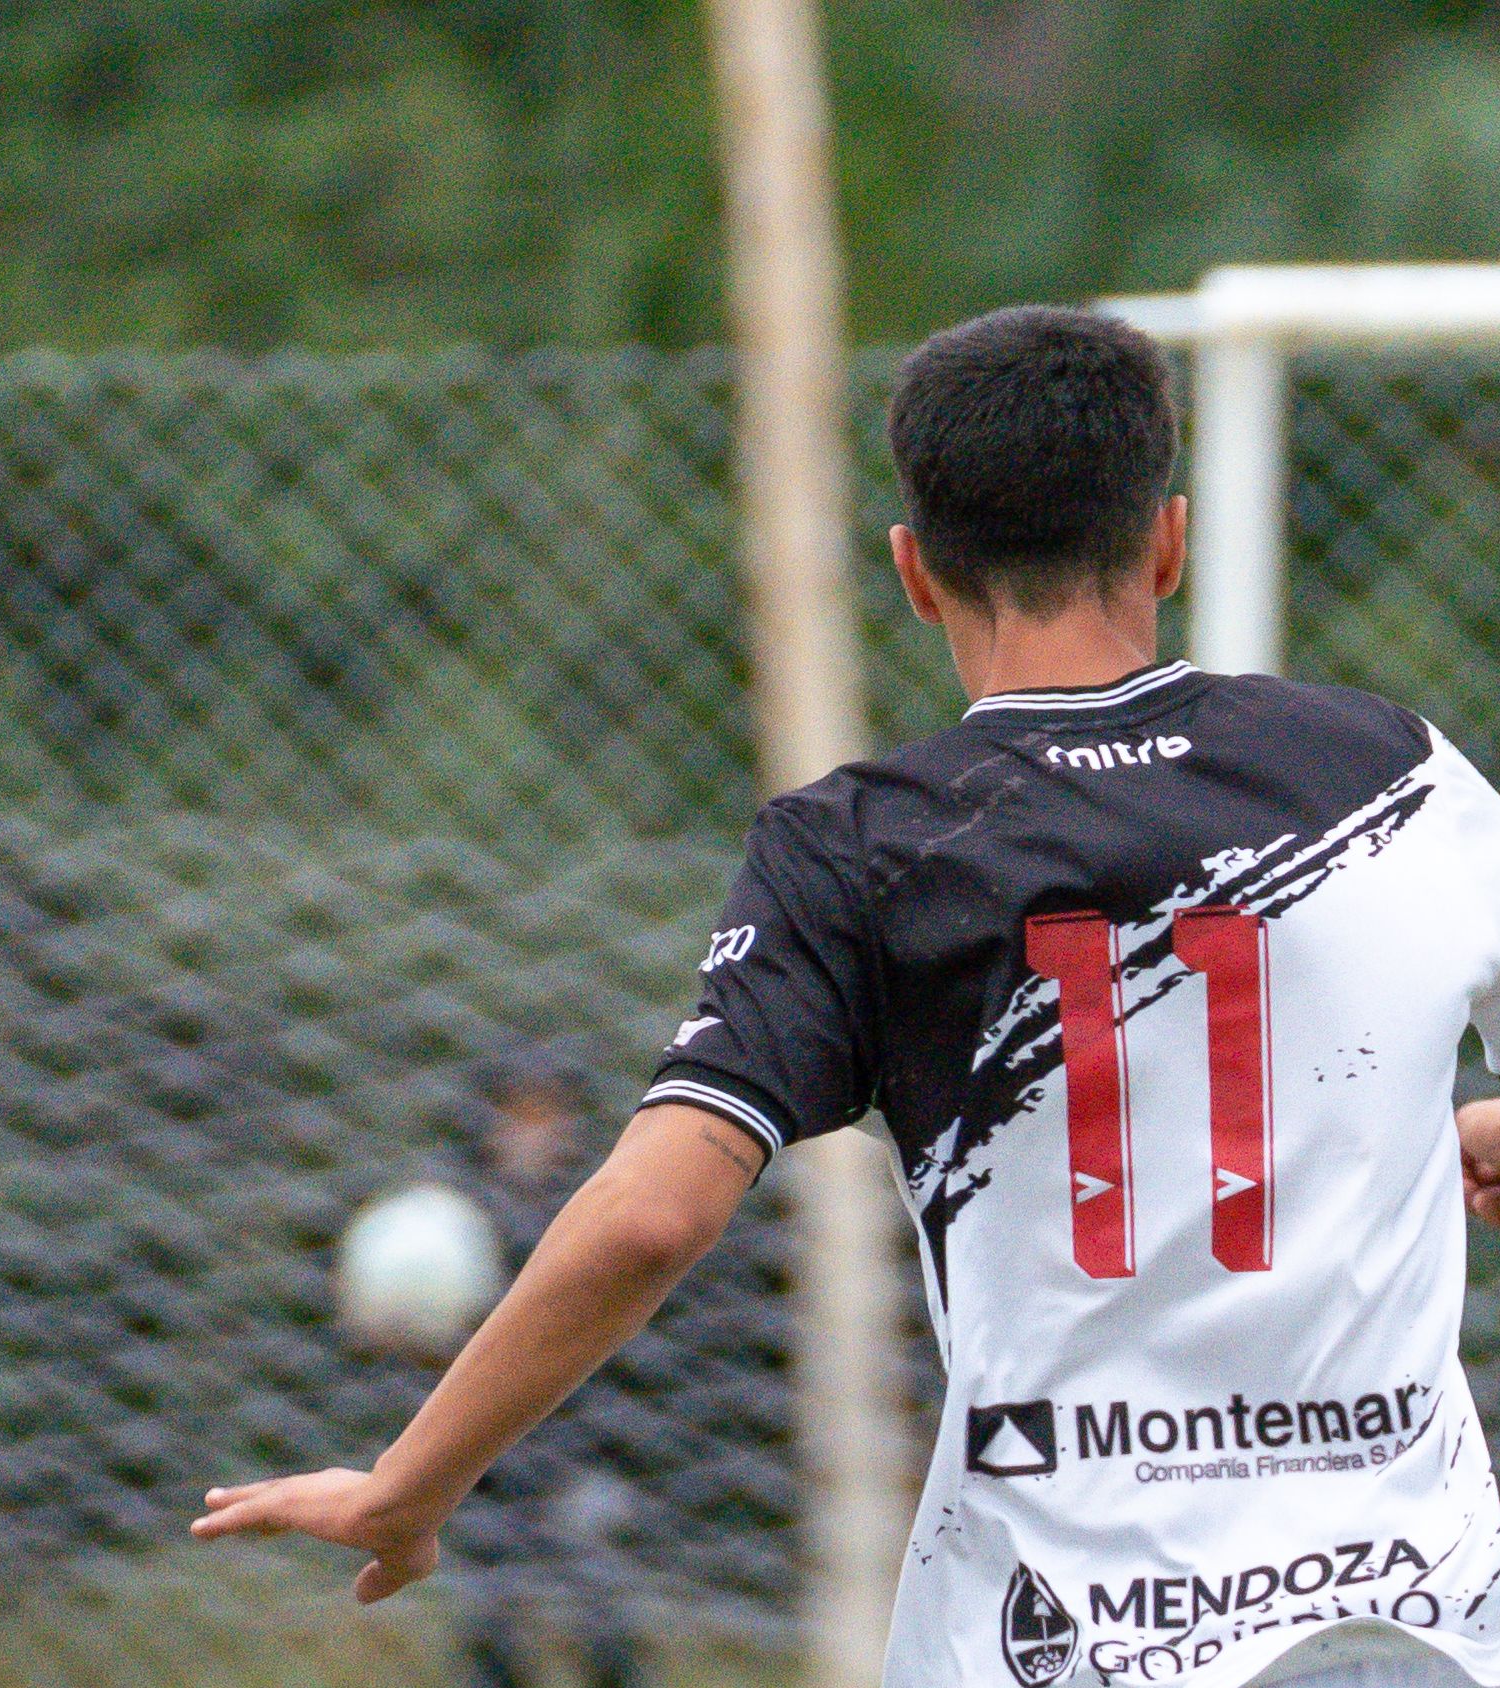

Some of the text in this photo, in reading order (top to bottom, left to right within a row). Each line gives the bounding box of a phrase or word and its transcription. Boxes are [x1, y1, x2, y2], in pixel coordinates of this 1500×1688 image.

[1025, 905, 1276, 1280] 11
[1075, 1382, 1416, 1460] Montemar
[1135, 1456, 1251, 1484] Compañía
[1256, 1450, 1365, 1479] Financiera
[1088, 1538, 1429, 1630] MENDOZA
